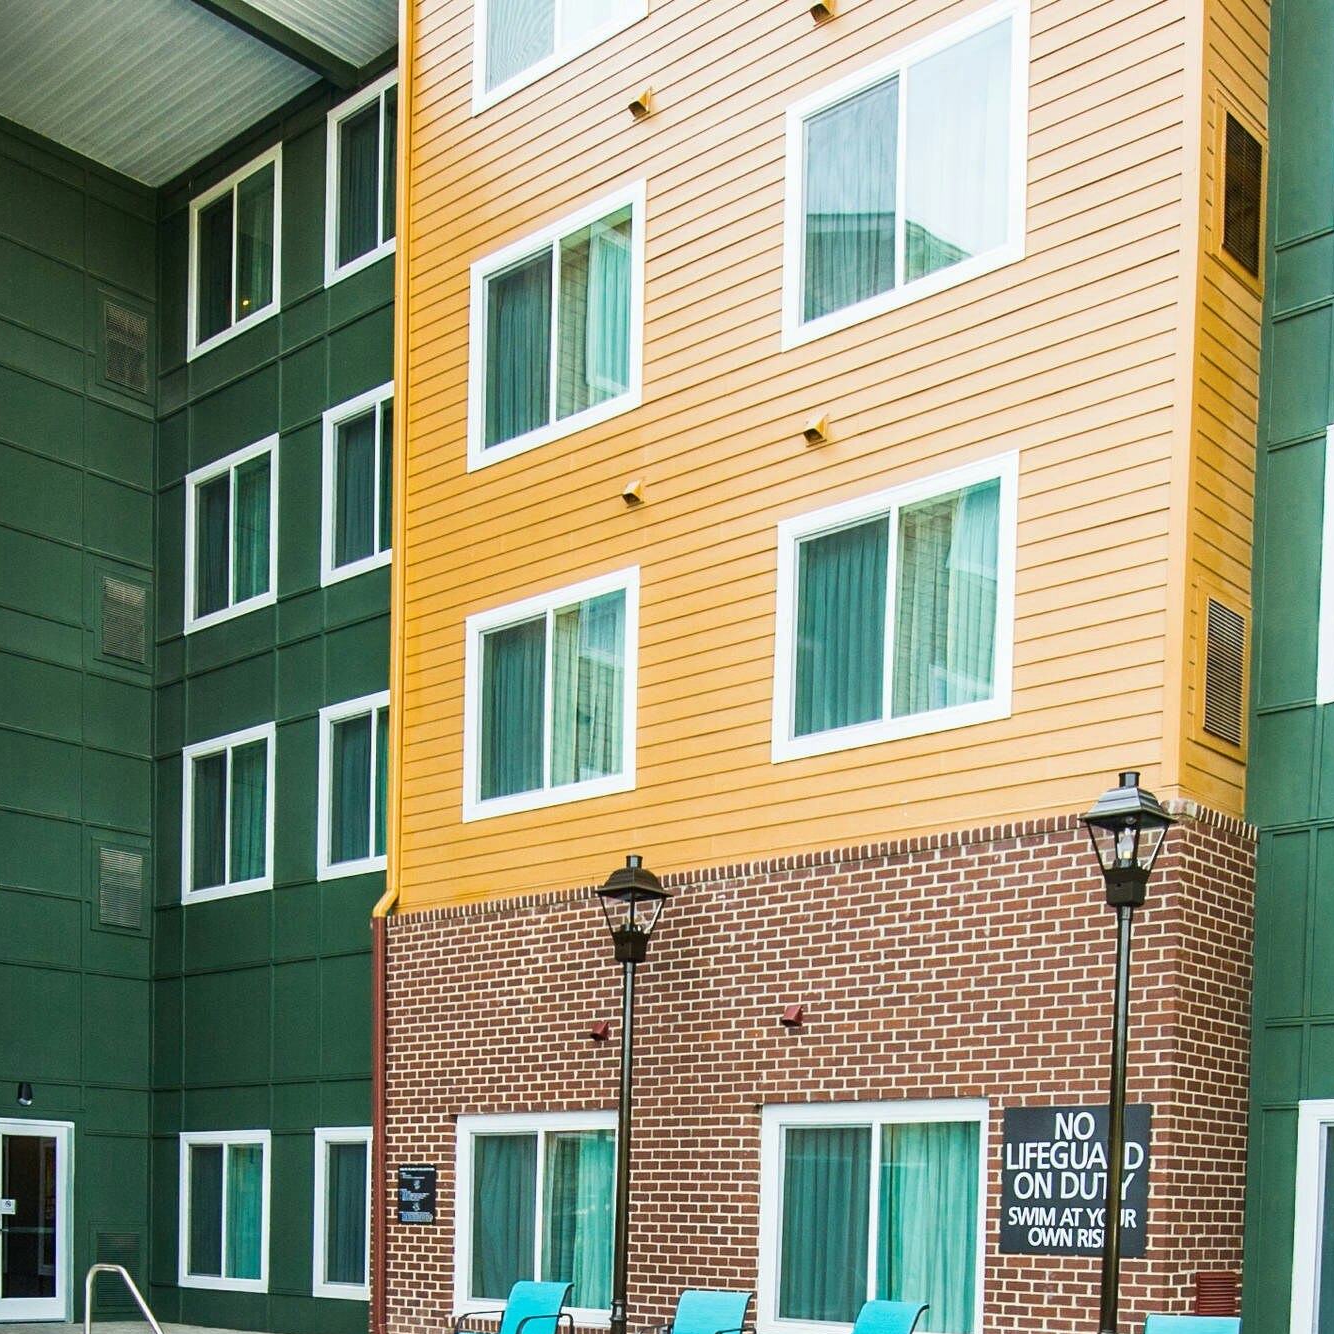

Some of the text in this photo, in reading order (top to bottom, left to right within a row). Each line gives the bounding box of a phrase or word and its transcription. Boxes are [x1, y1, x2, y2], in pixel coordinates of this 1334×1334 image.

[1054, 1111, 1095, 1140] NO
[1006, 1141, 1144, 1170] LIFEGUAD
[1013, 1171, 1053, 1199] ON
[1008, 1207, 1056, 1226] SWIM
[1059, 1207, 1084, 1226] AT
[1028, 1228, 1105, 1249] OWN RIS
